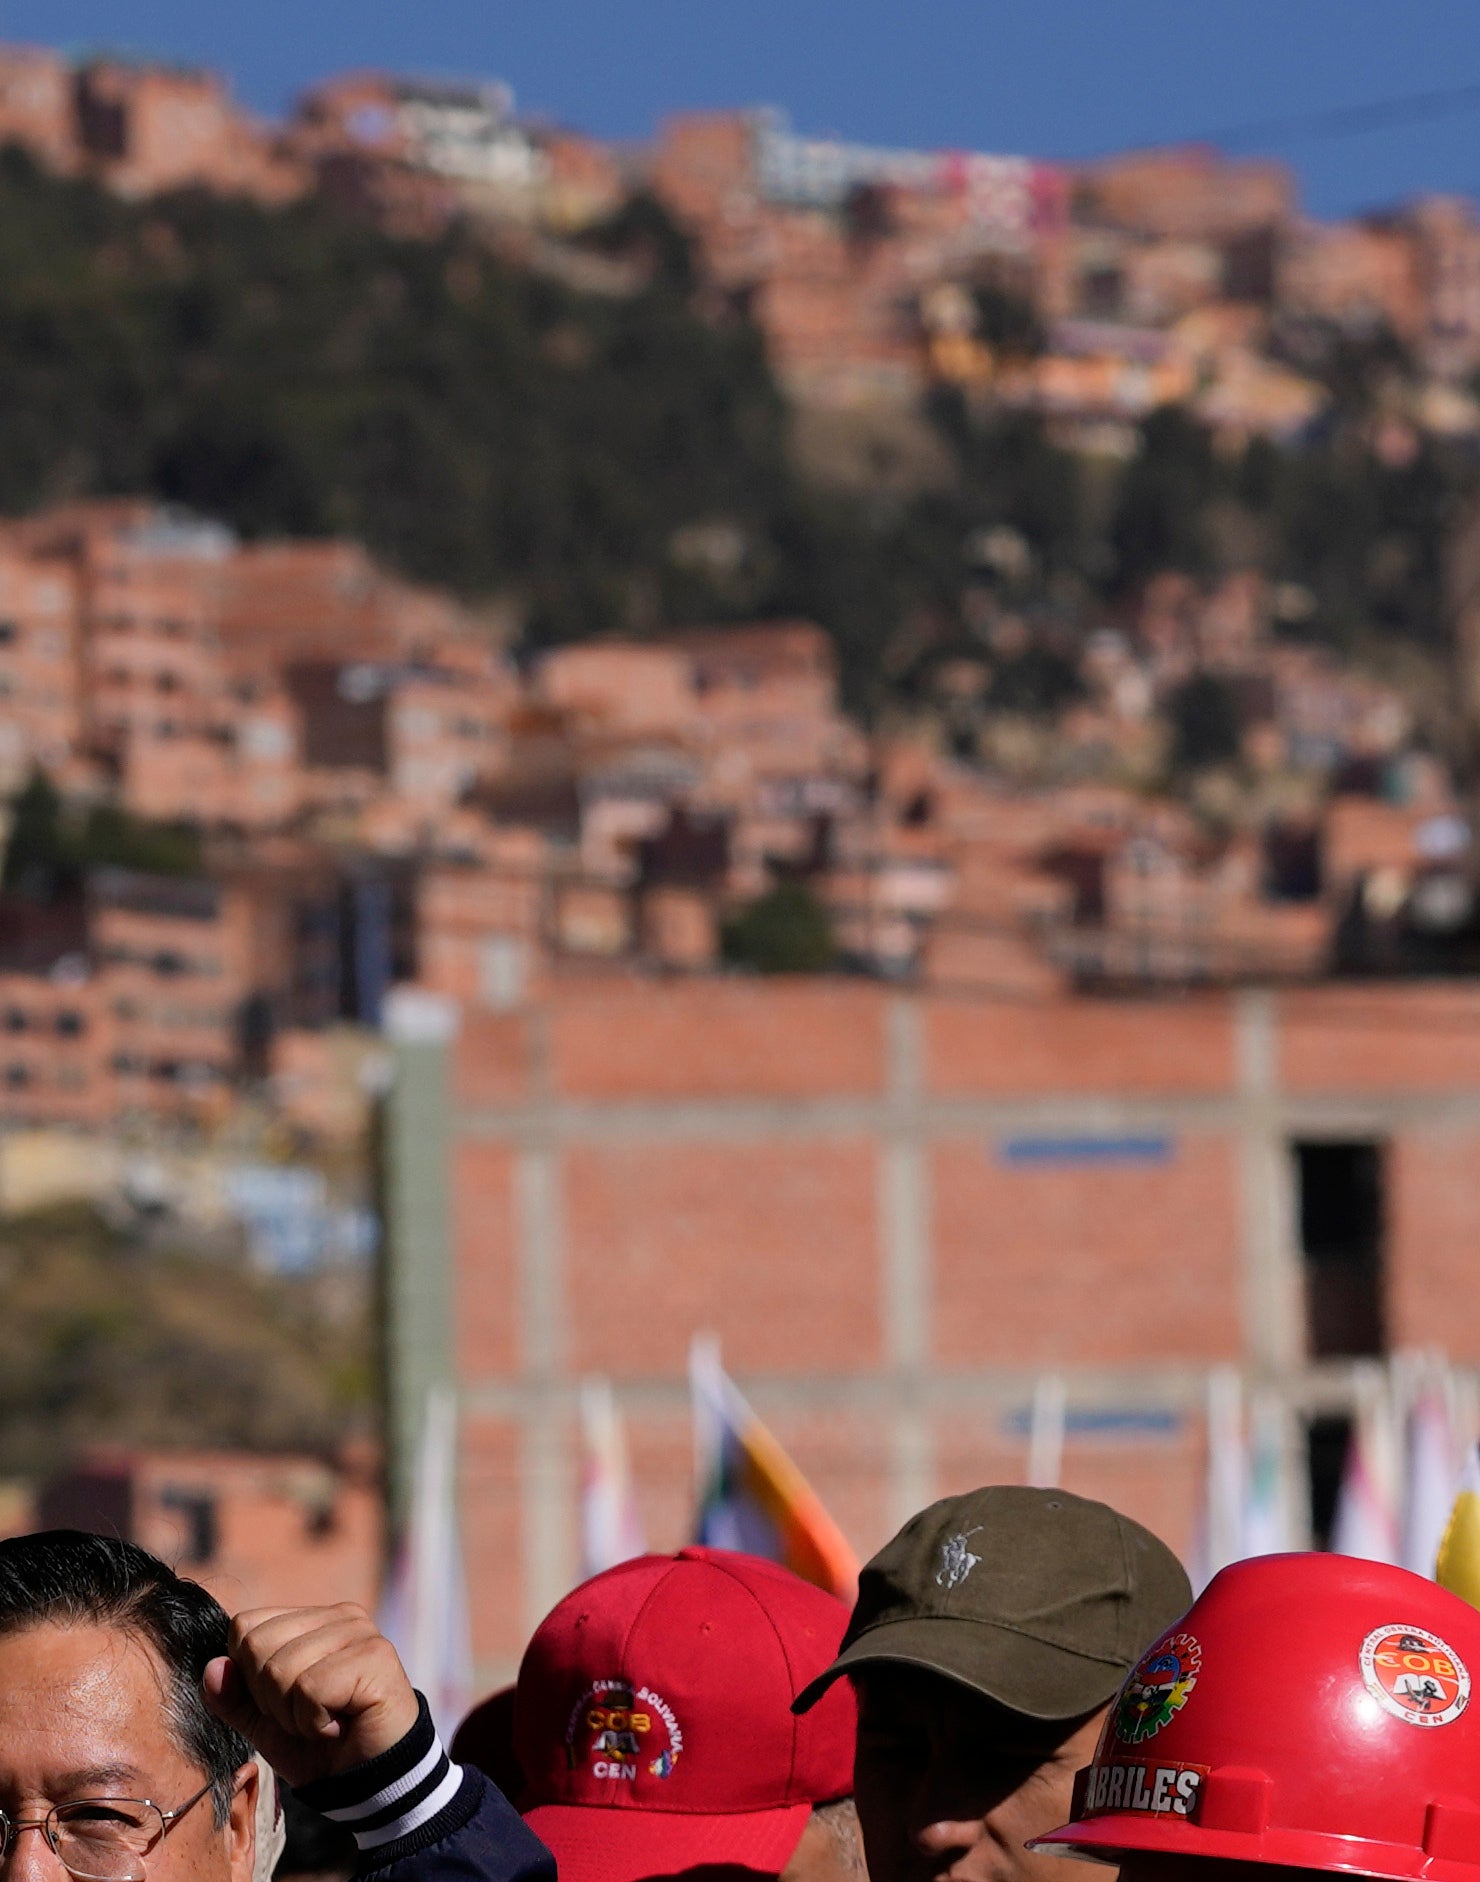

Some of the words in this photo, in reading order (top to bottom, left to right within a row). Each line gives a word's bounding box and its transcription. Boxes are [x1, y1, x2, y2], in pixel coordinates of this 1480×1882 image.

[1375, 1651, 1456, 1676] COB
[586, 1710, 652, 1733] COB
[1404, 1711, 1444, 1724] CEN
[592, 1761, 637, 1780] CEN
